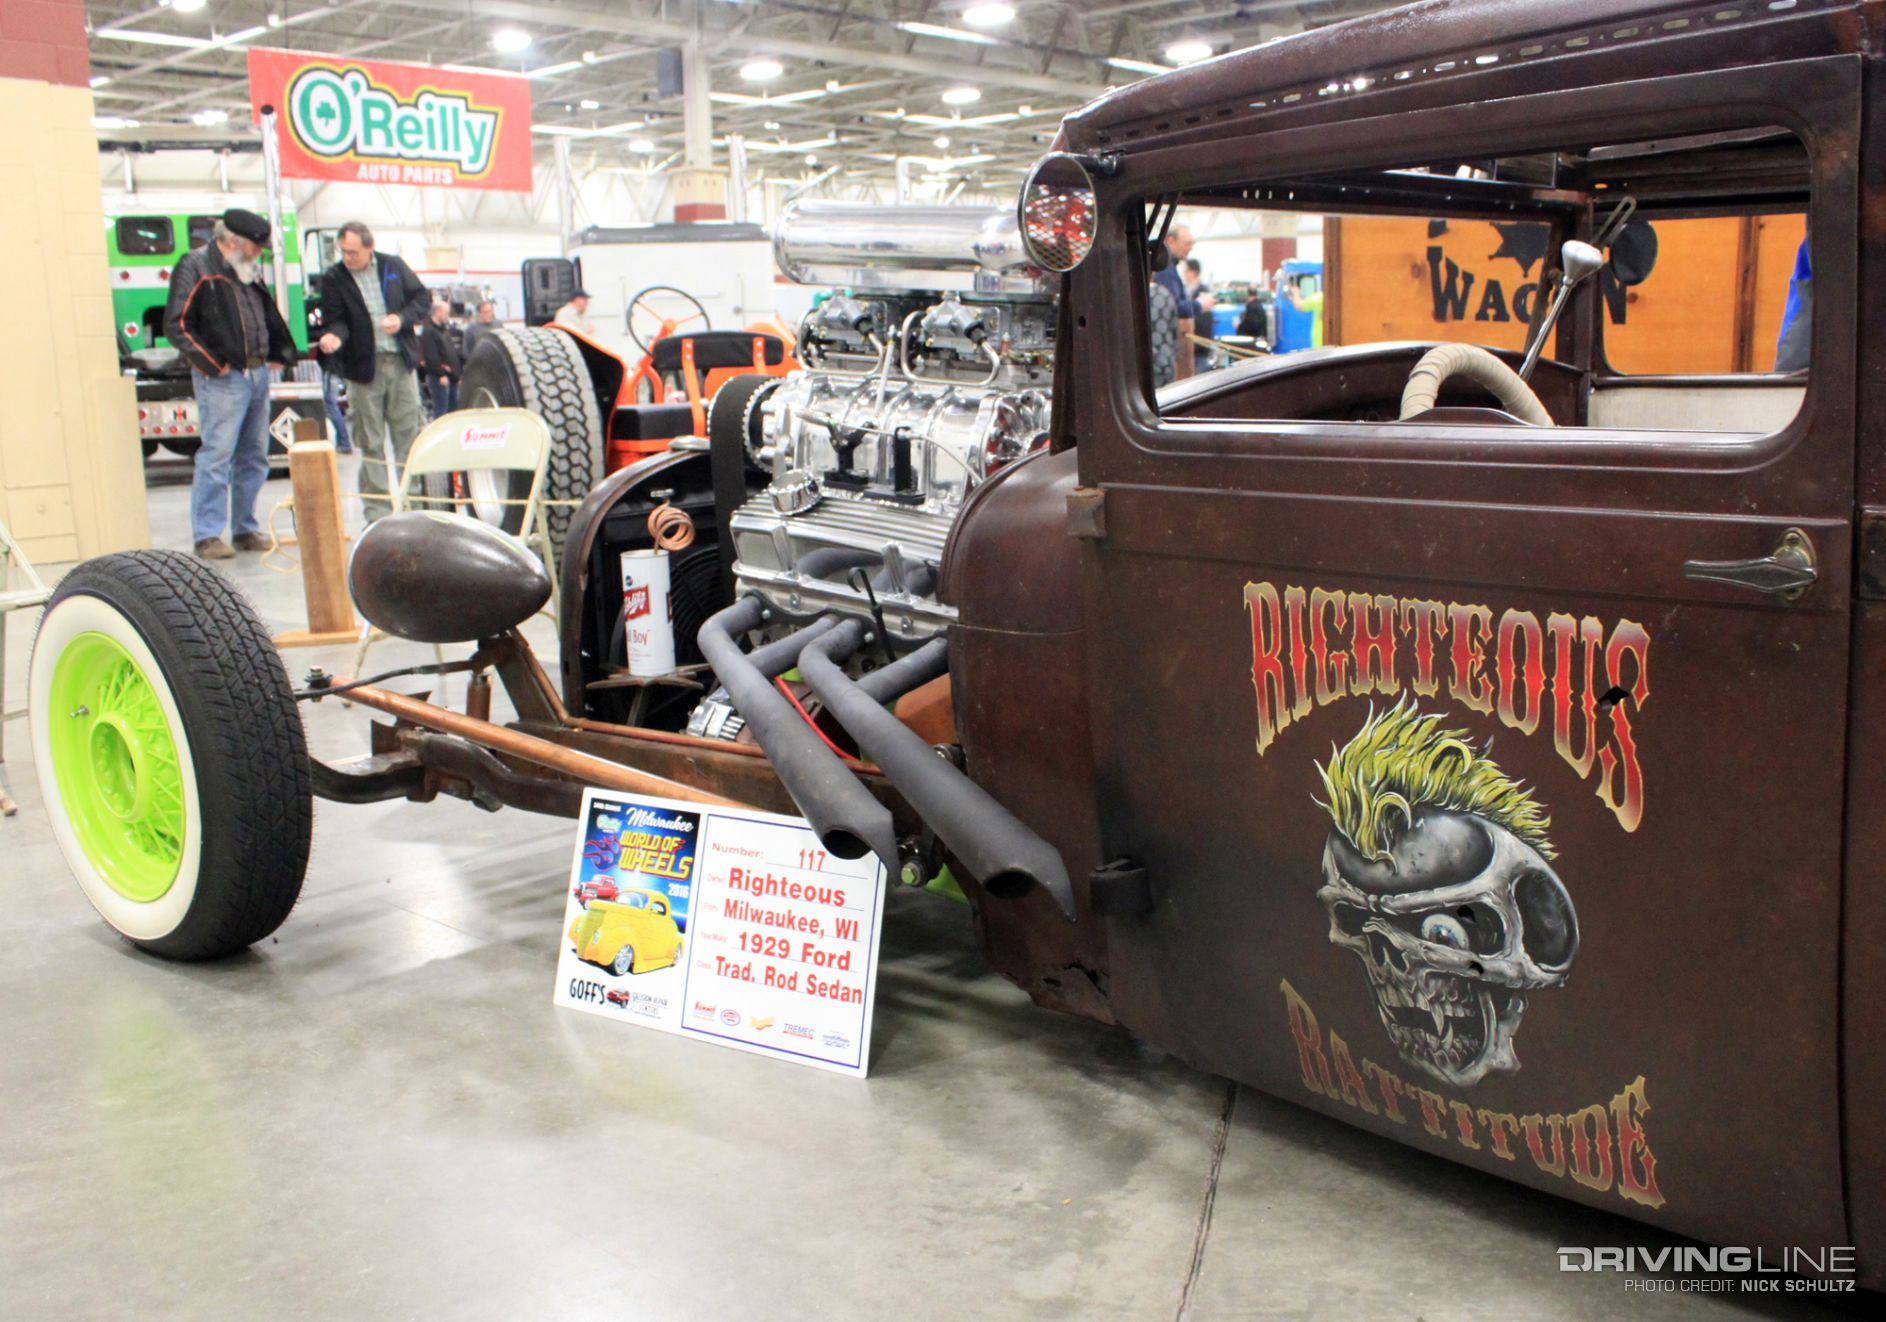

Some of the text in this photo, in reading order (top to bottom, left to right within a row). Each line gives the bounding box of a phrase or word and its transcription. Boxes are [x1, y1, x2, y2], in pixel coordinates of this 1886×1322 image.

[299, 79, 487, 164] O'Reilly
[357, 164, 453, 184] AUTO PARTS
[1243, 581, 1651, 833] RIGHTEOUS
[626, 807, 694, 832] Milwaukee
[619, 830, 684, 854] WORLD OF
[711, 842, 764, 859] Number:
[618, 847, 694, 880] WHEELS
[799, 848, 826, 872] 117
[728, 867, 846, 907] Righteous
[723, 898, 859, 942] Milwaukee, WI
[739, 931, 851, 972] 1929 Ford
[569, 978, 607, 1005] GOFF'S
[715, 955, 863, 1005] Trad. Rod Sedan
[783, 1023, 815, 1037] TREMEC
[1280, 978, 1667, 1210] RATTITUDE
